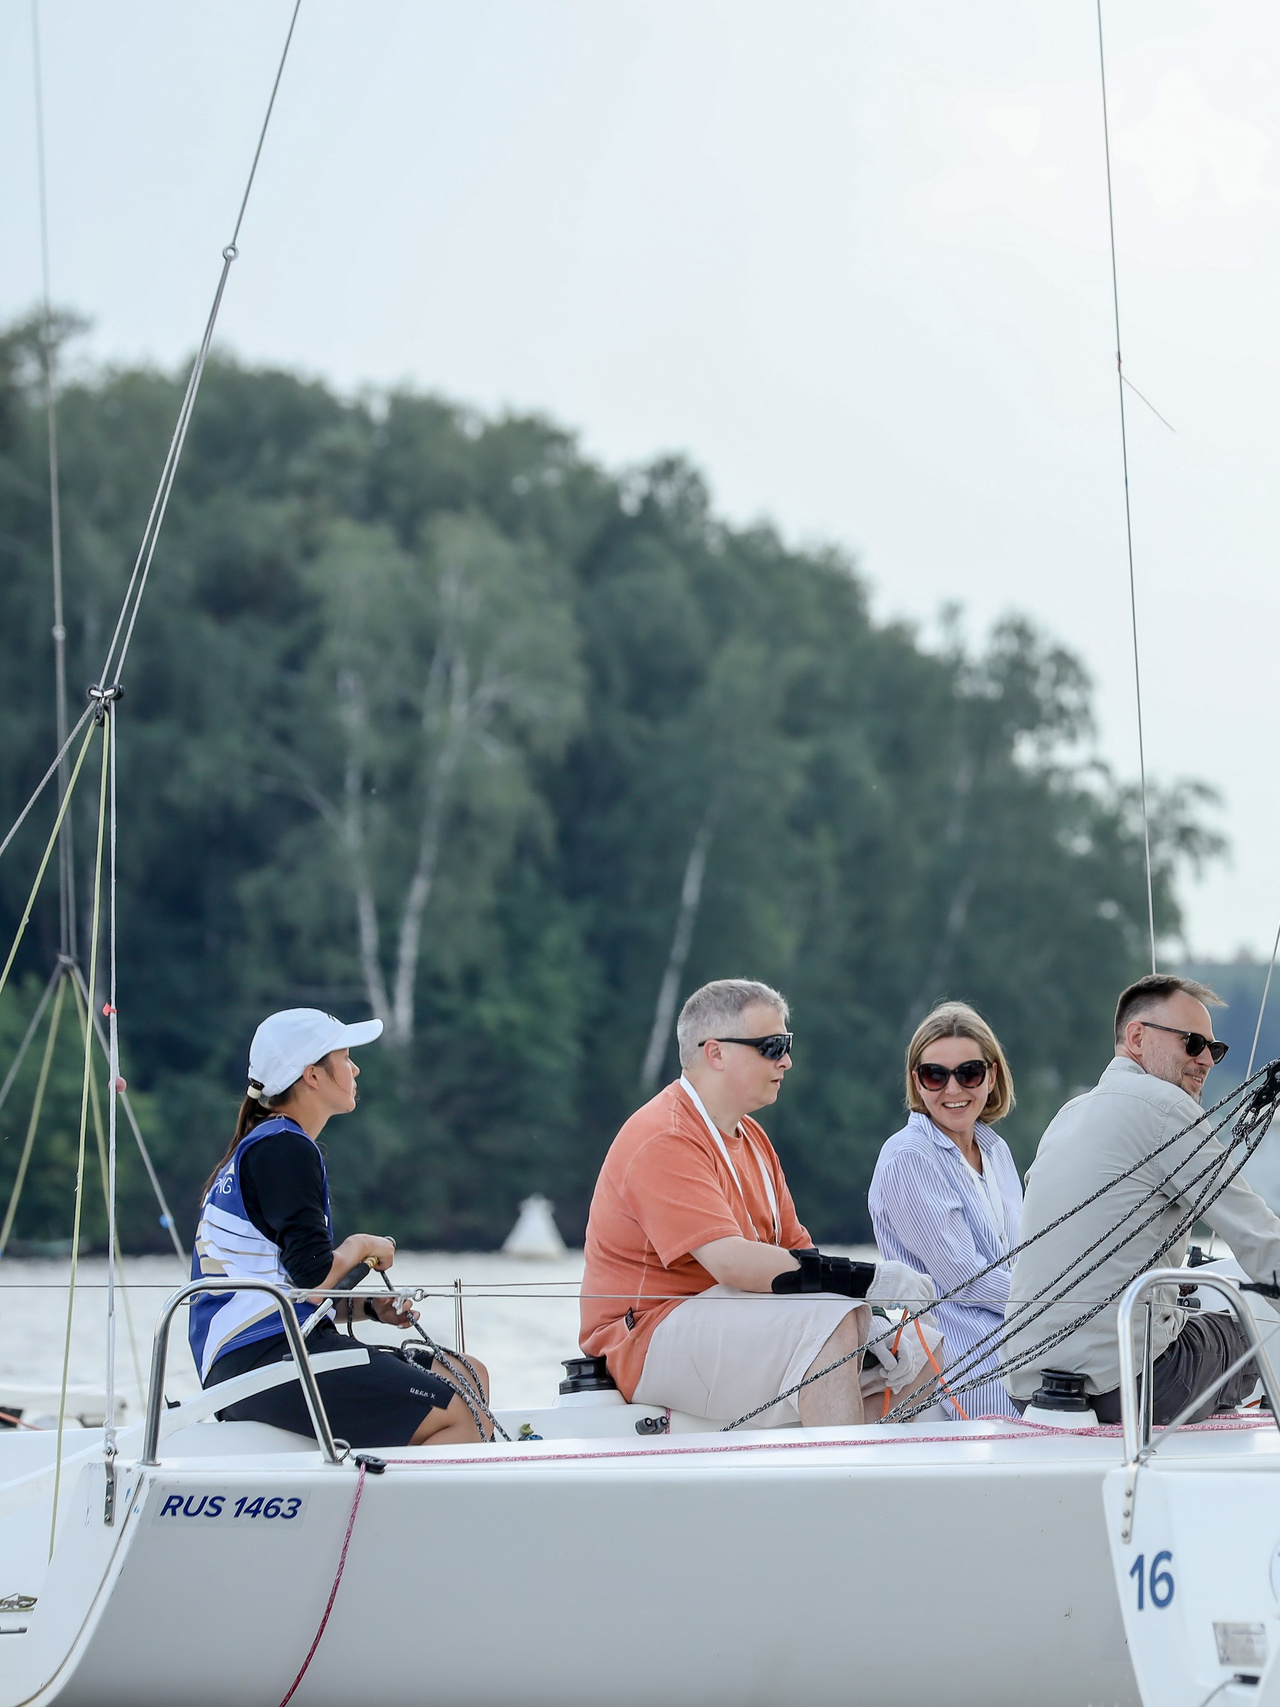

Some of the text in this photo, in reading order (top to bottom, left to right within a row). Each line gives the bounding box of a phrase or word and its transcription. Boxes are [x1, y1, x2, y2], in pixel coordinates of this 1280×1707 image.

[159, 1494, 303, 1520] RUS 1463
[1129, 1550, 1175, 1612] 16
